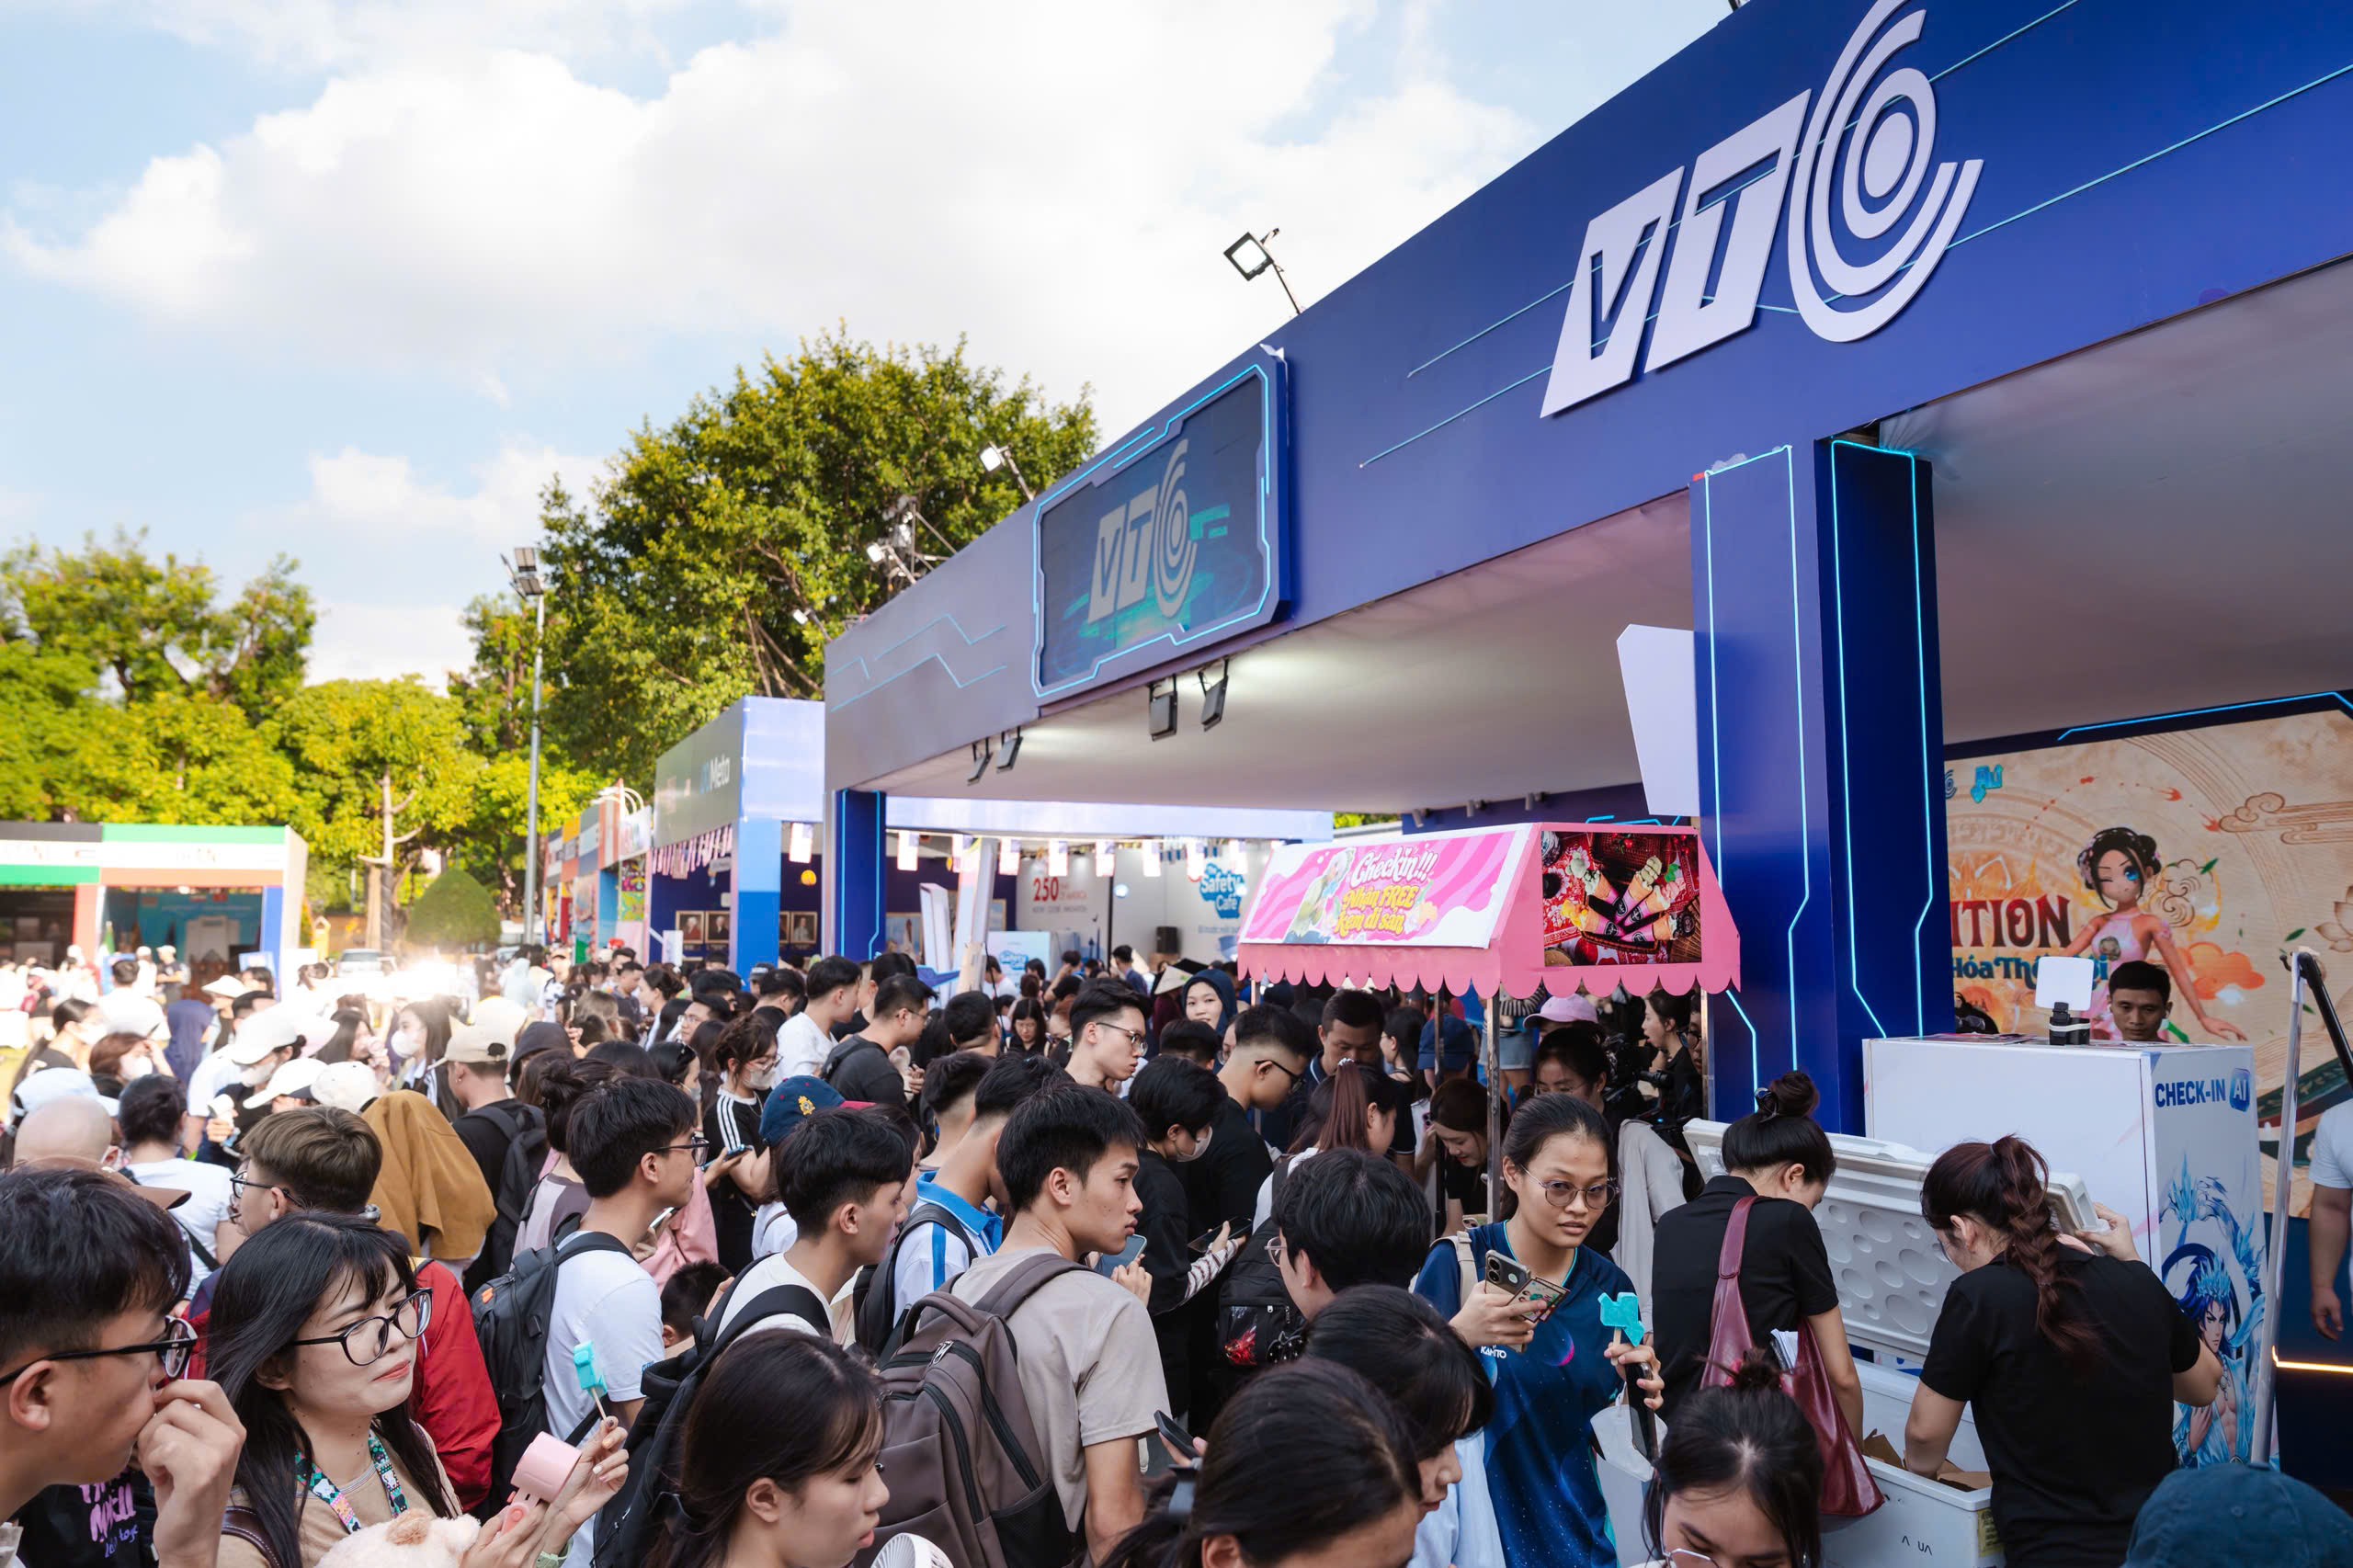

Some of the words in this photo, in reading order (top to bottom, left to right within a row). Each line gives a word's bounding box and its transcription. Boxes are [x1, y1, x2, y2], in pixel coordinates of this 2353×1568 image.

[1540, 0, 1984, 418] VTC
[710, 753, 731, 791] Meta
[1350, 846, 1438, 889] Checkin!!!
[1032, 876, 1059, 902] 250
[1380, 884, 1419, 909] FREE
[2154, 1079, 2226, 1108] CHECK-IN
